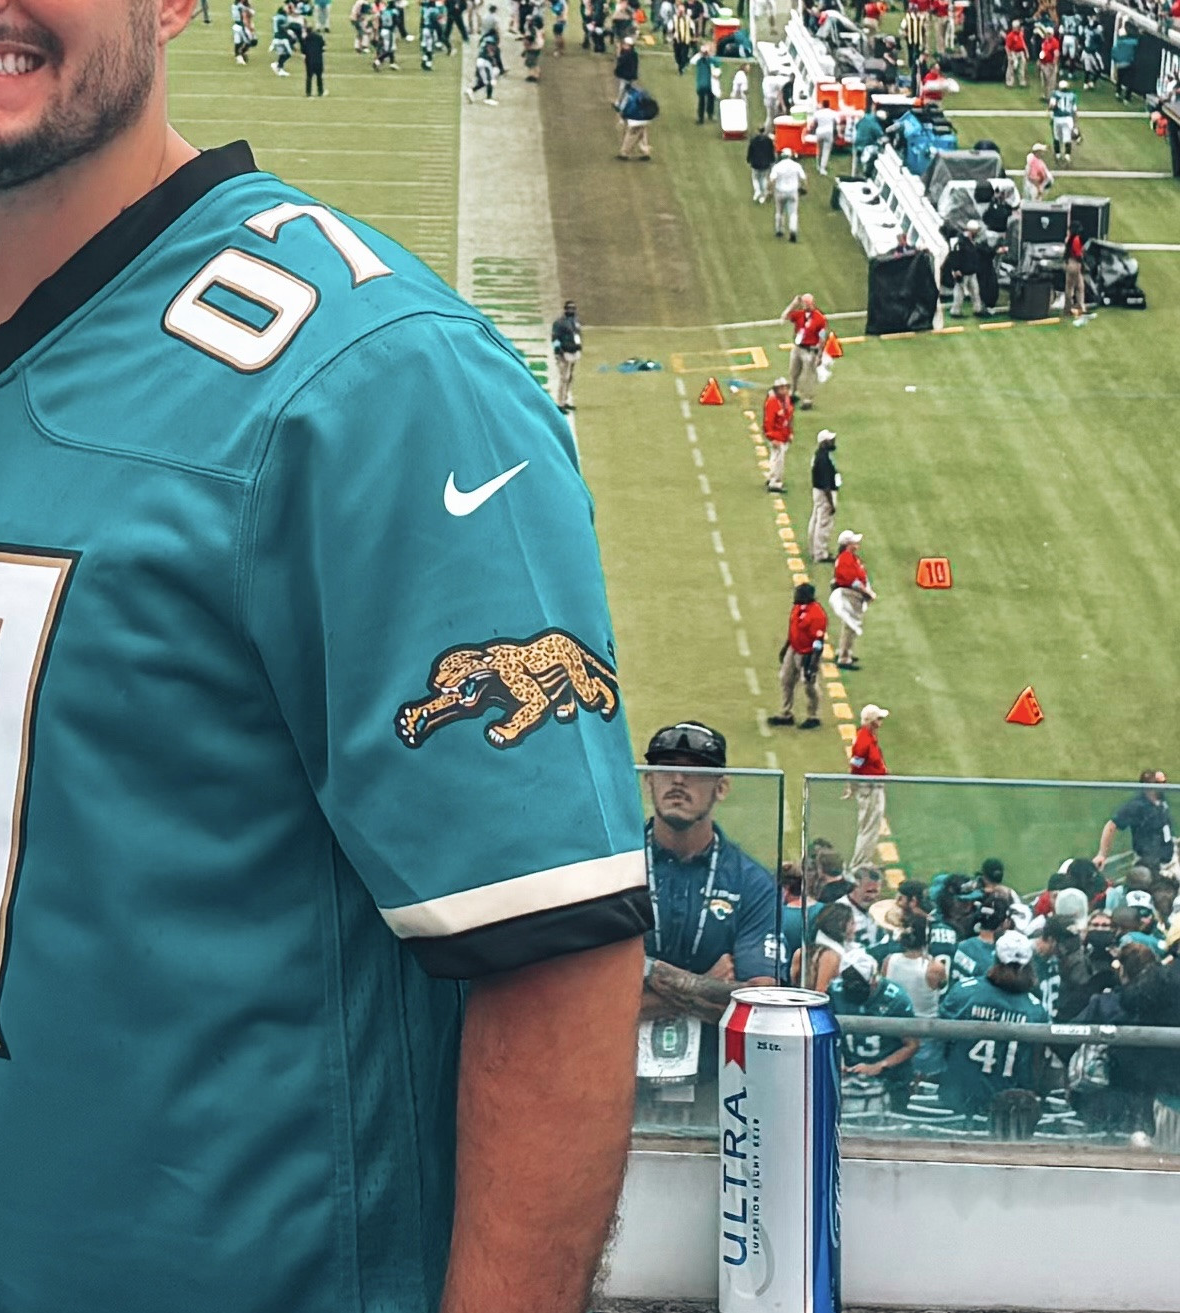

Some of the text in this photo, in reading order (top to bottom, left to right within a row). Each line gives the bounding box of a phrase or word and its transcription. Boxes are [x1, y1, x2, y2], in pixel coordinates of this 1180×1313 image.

[160, 200, 396, 376] 07
[925, 561, 946, 584] 10
[968, 1039, 1019, 1077] 41
[723, 1087, 748, 1267] ULTRA
[752, 1158, 761, 1189] LIGHT
[752, 1196, 761, 1255] SUPERIOR
